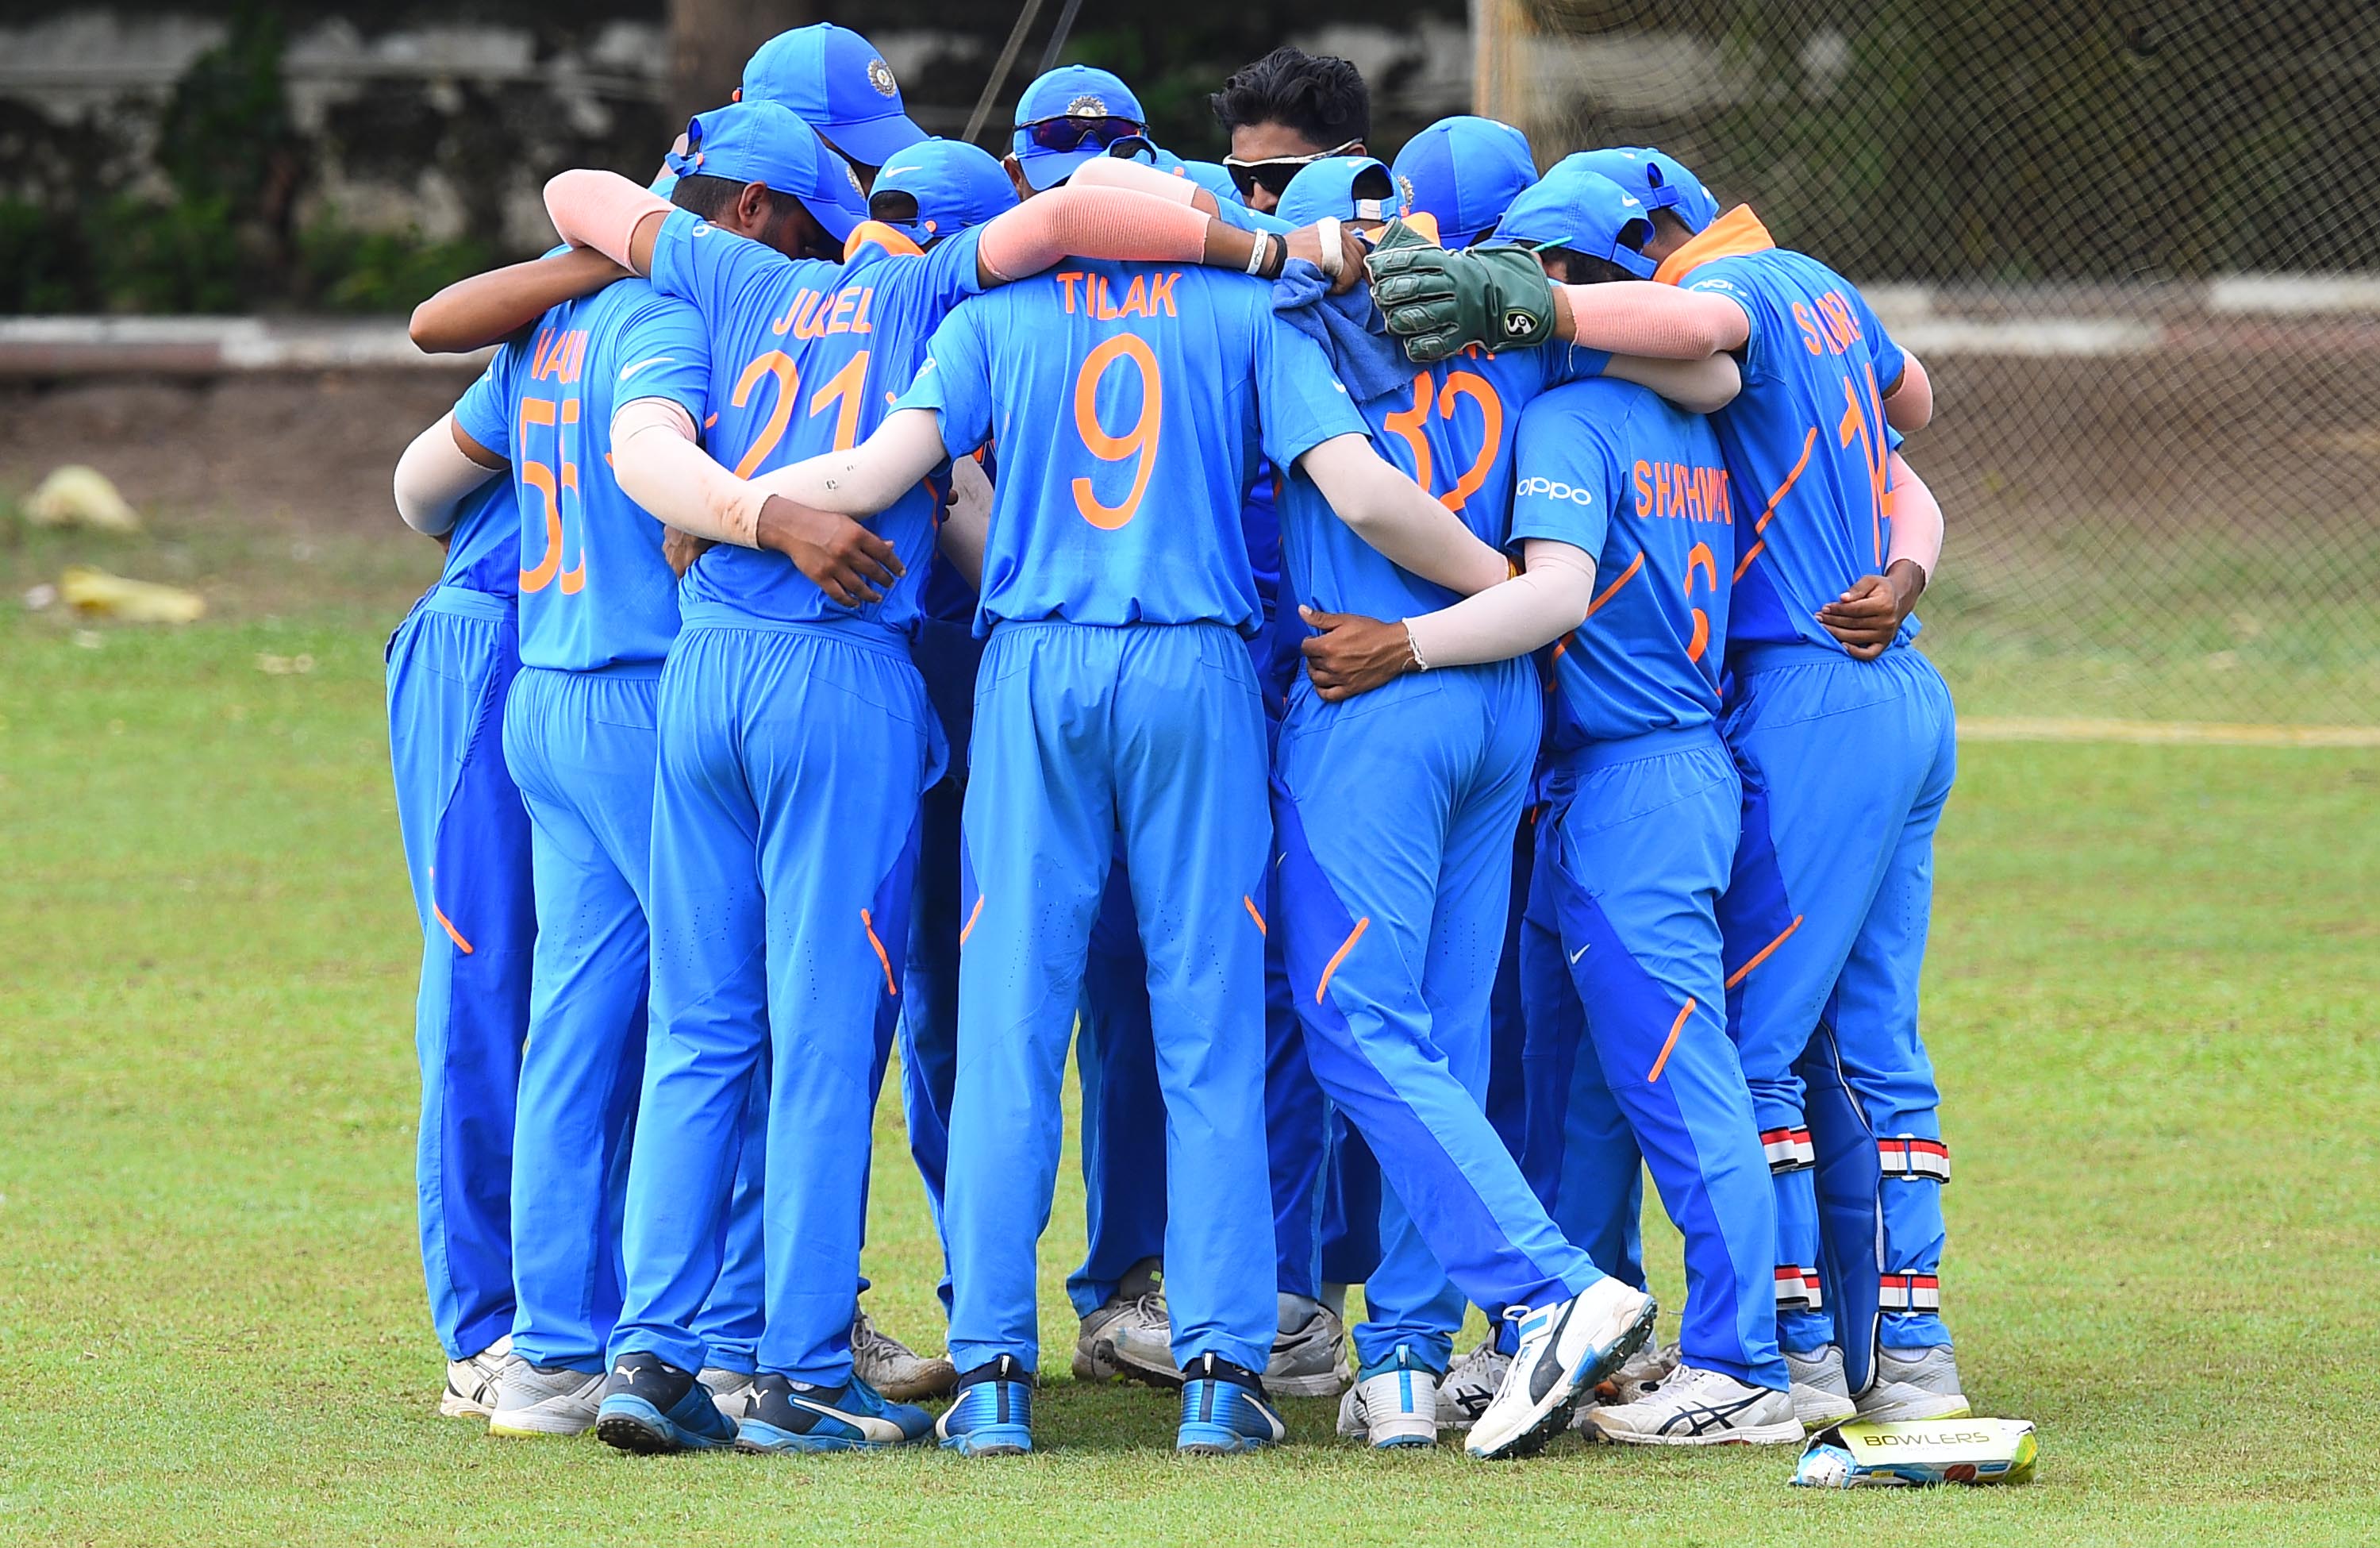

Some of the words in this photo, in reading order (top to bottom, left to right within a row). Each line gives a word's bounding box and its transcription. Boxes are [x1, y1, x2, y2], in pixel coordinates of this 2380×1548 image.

[1056, 271, 1182, 321] TILAK
[732, 349, 871, 482] 21
[1071, 332, 1162, 530] 9
[1863, 1431, 1990, 1446] BOWLERS
